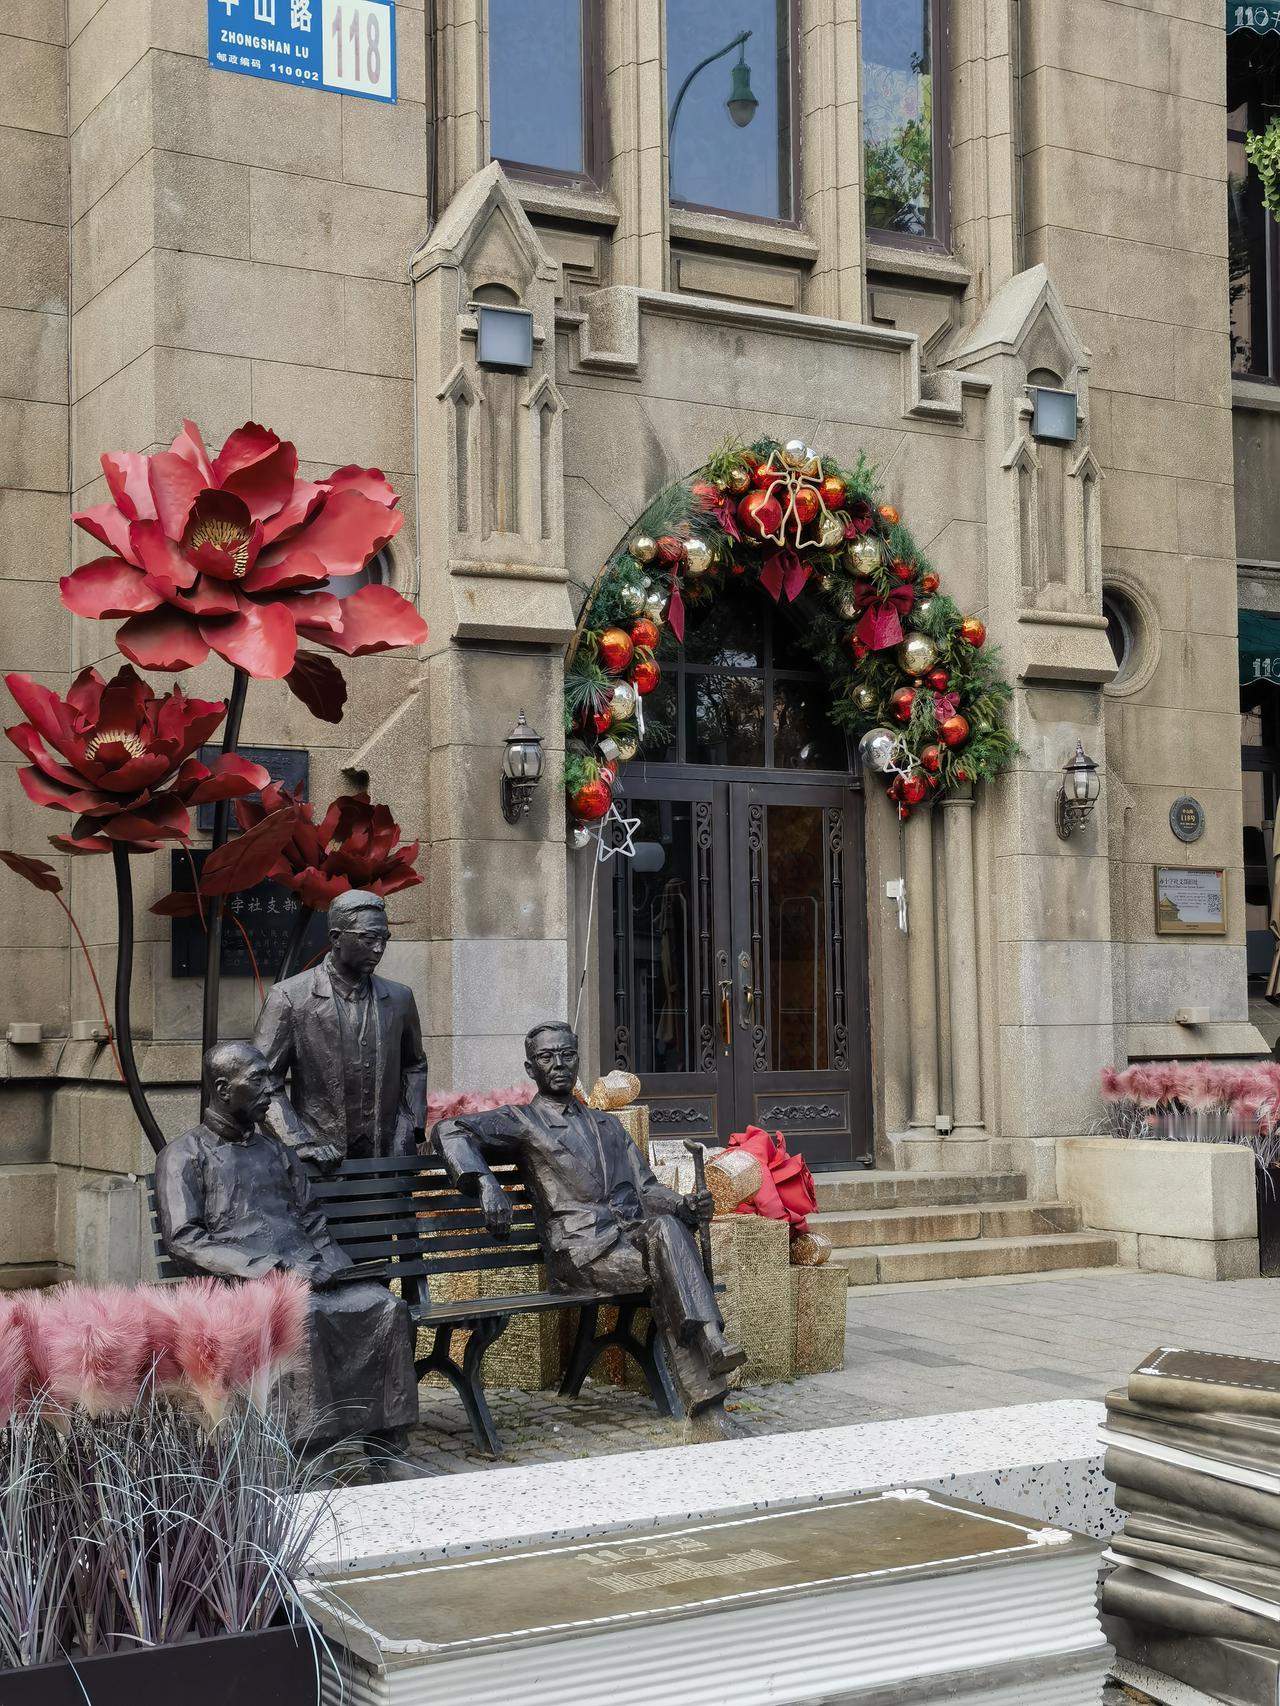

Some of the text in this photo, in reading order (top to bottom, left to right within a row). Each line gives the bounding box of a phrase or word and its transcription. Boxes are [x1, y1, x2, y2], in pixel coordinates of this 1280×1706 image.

[220, 29, 309, 59] ZHONGSHAN LU
[332, 5, 381, 84] 118
[216, 52, 319, 81] 邮政编码 110002
[223, 896, 304, 914] 字社支部
